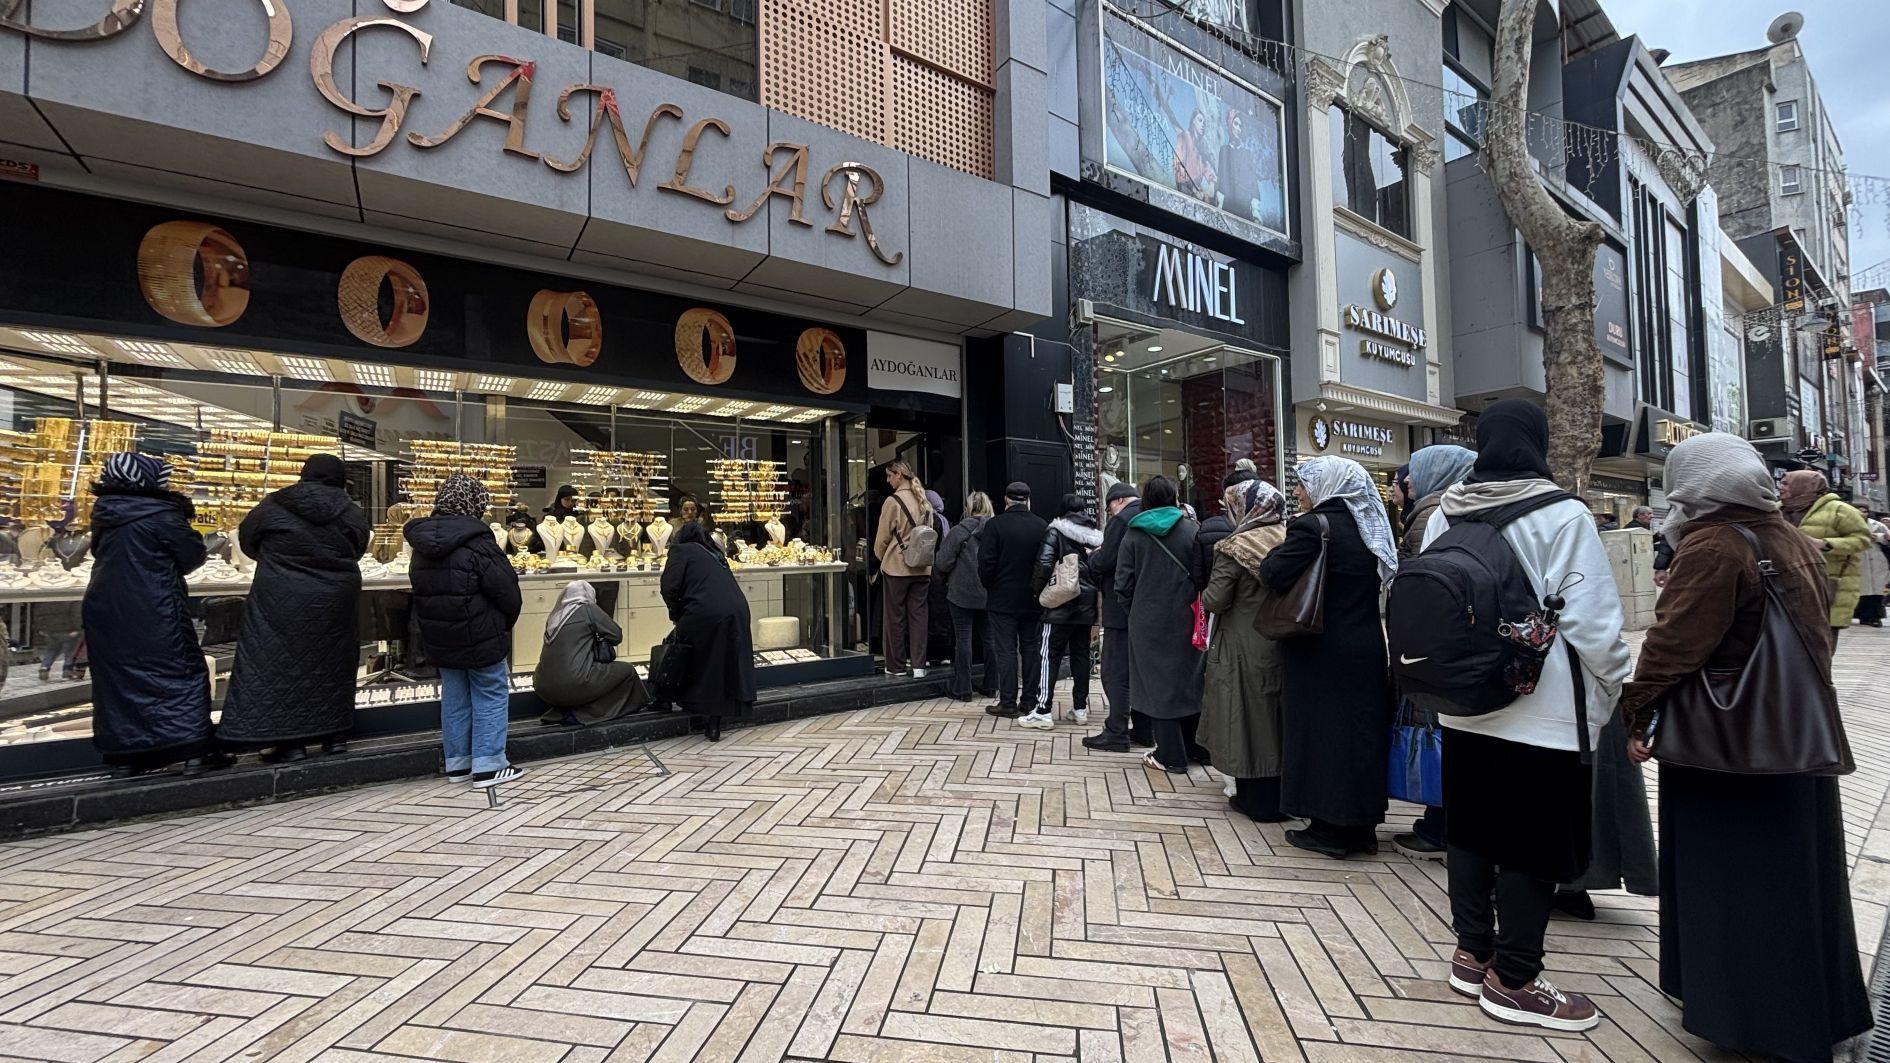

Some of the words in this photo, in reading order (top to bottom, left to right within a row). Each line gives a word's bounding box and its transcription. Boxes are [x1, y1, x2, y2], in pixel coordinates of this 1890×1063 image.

[1168, 55, 1222, 101] MİNEL
[1153, 243, 1246, 325] MİNEL
[1348, 304, 1428, 350] SARIMEŞE
[1365, 340, 1416, 366] KUYUMCUSU
[870, 358, 958, 382] AYDOĞANLAR
[1332, 420, 1394, 447] SARIMEŞE
[1343, 443, 1383, 456] KUYUMCUSU
